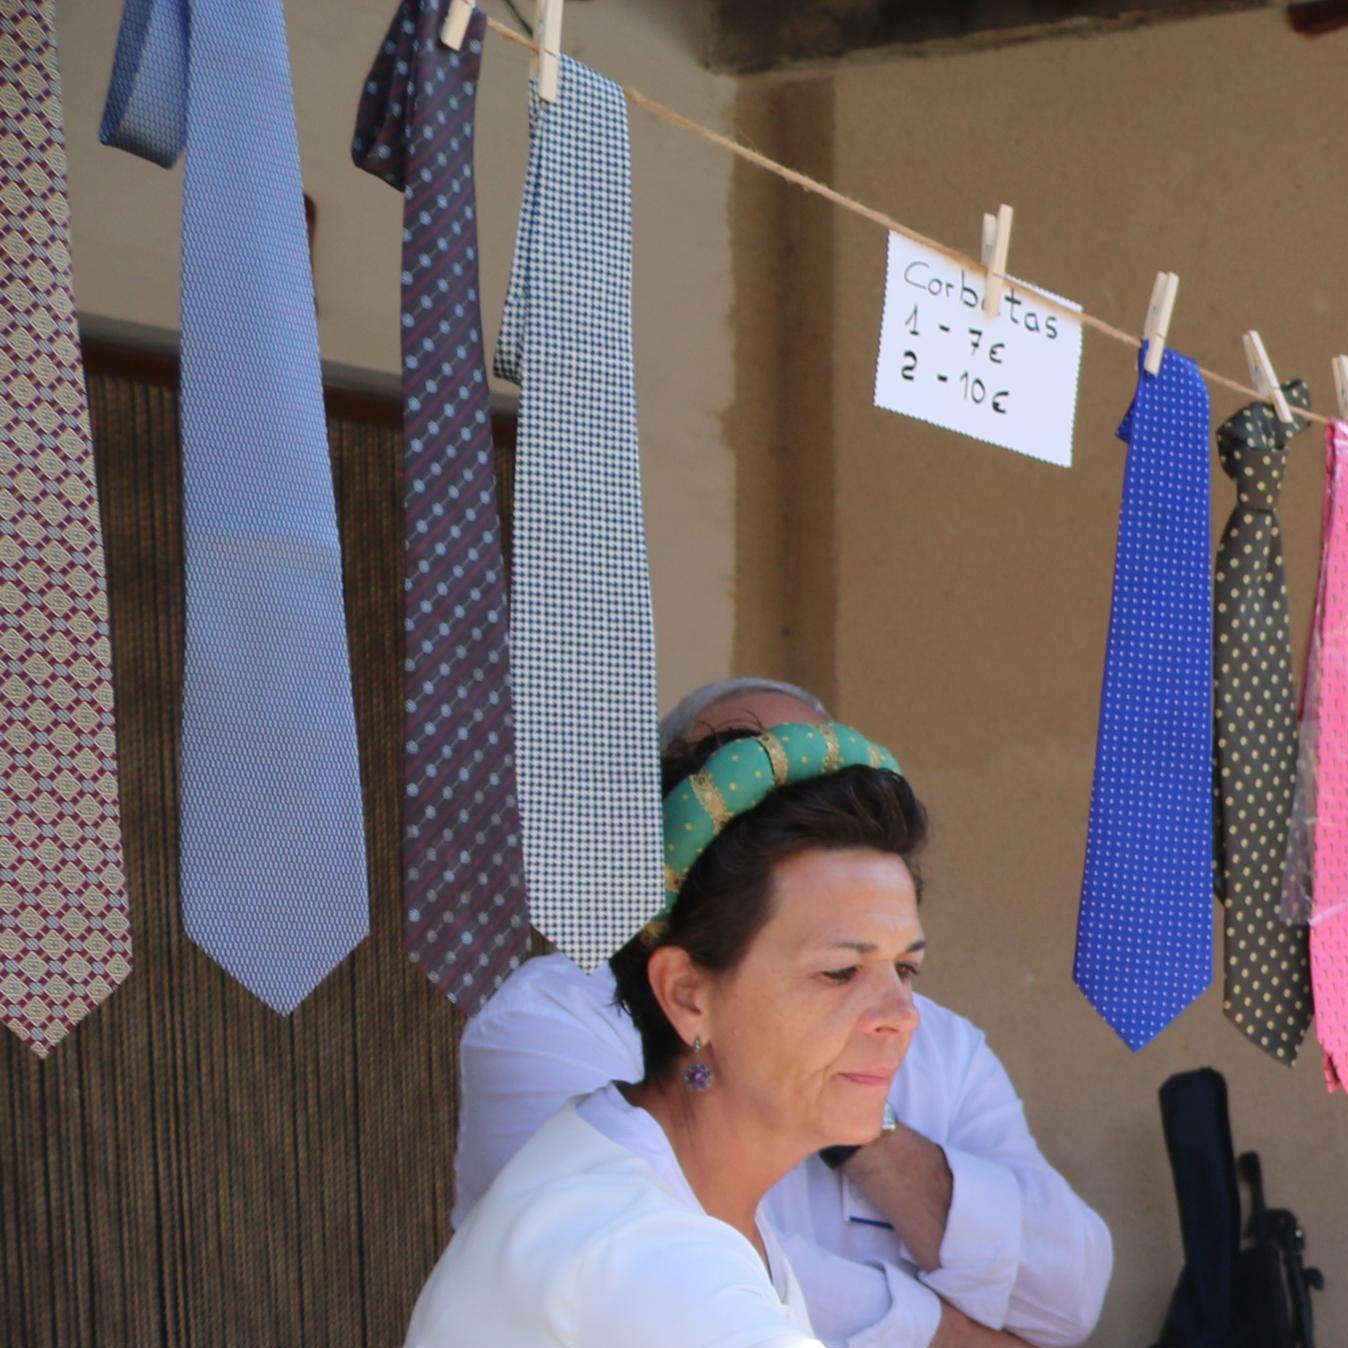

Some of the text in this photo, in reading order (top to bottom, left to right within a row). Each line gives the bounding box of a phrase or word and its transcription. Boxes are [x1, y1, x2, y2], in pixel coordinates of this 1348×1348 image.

[904, 261, 1058, 339] Corbtas
[904, 303, 920, 336] 1
[901, 350, 918, 381] 2
